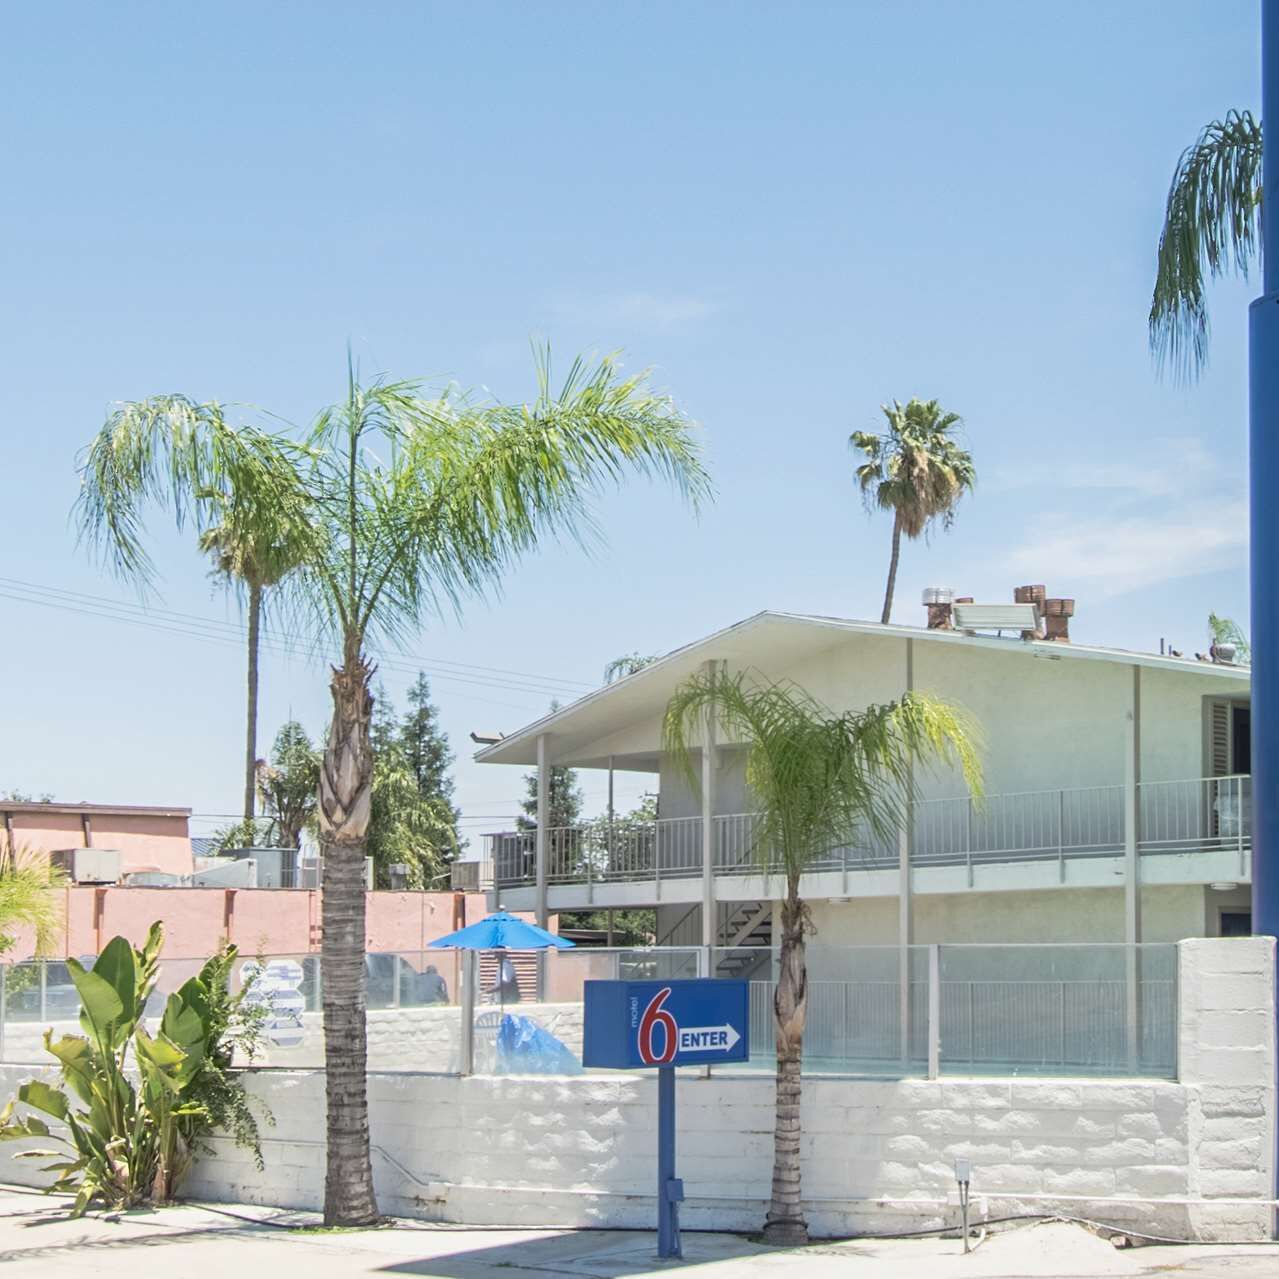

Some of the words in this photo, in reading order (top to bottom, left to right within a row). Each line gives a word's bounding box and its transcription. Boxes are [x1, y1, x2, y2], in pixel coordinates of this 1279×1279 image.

[630, 997, 638, 1028] motel
[637, 987, 679, 1065] 6
[681, 1031, 728, 1048] ENTER
